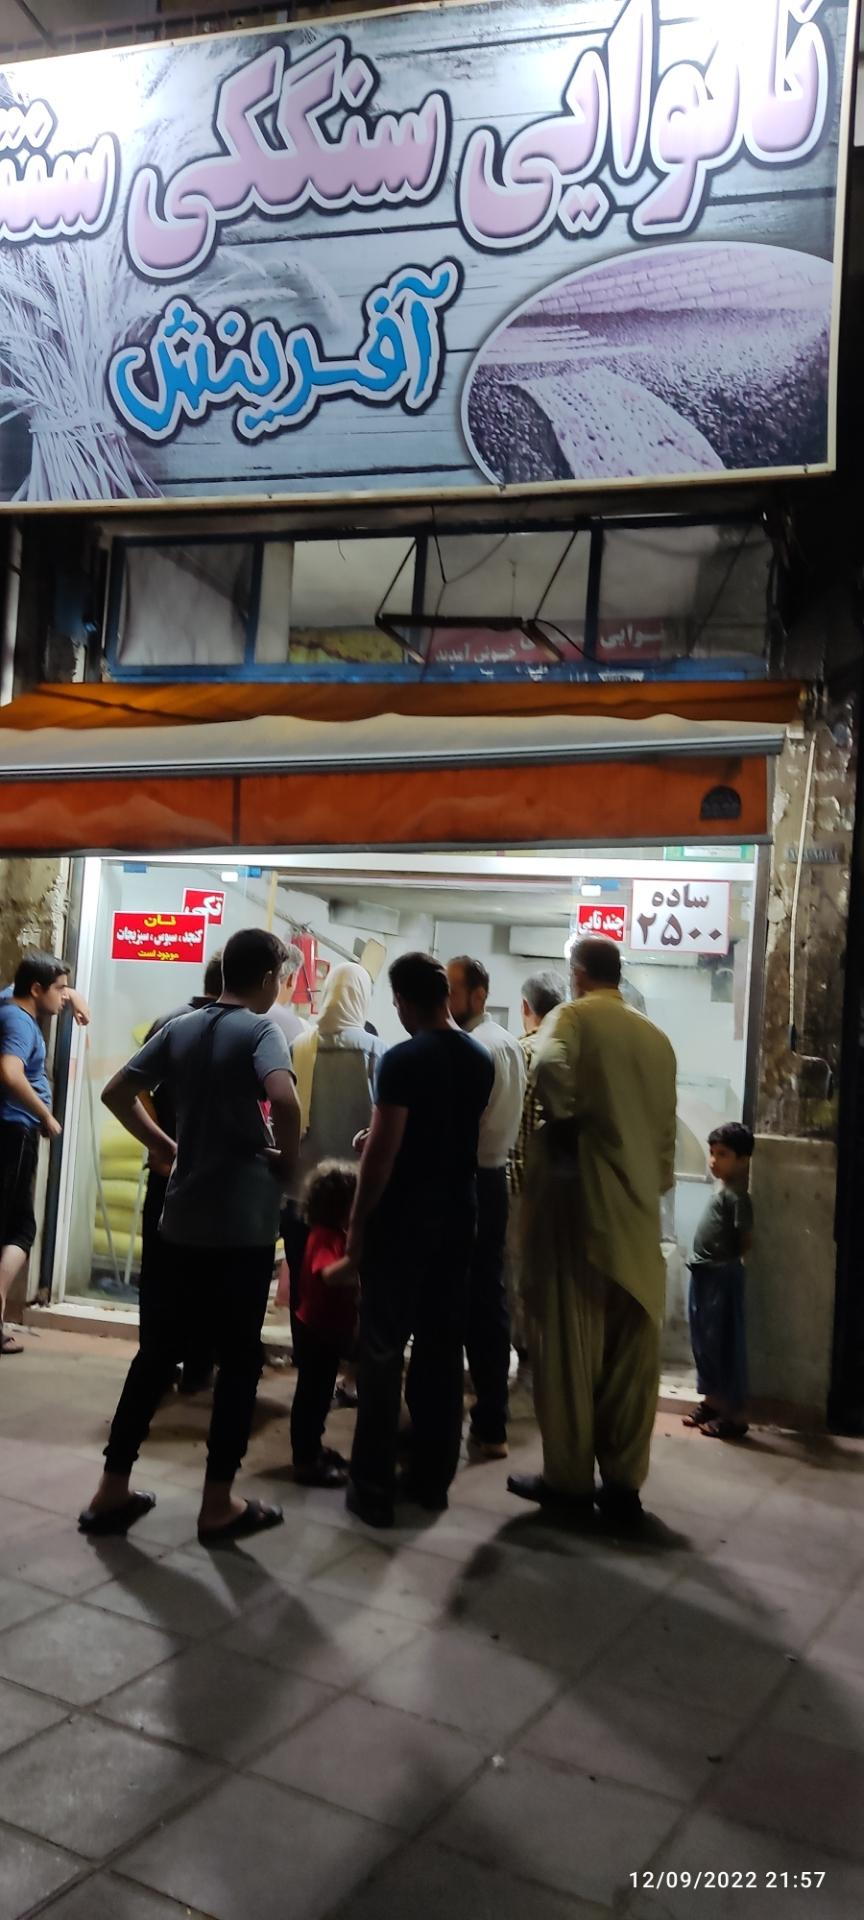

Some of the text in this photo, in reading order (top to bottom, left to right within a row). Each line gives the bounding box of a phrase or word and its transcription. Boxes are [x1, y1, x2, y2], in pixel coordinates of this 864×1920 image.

[0, 98, 116, 241] سنت
[128, 41, 447, 279] سنگکی
[108, 261, 461, 441] آفرینش
[651, 883, 710, 909] ساده
[143, 914, 177, 928] نان
[602, 913, 624, 938] چند
[636, 912, 723, 947] ۲۵۰۰
[137, 949, 180, 961] موجود است
